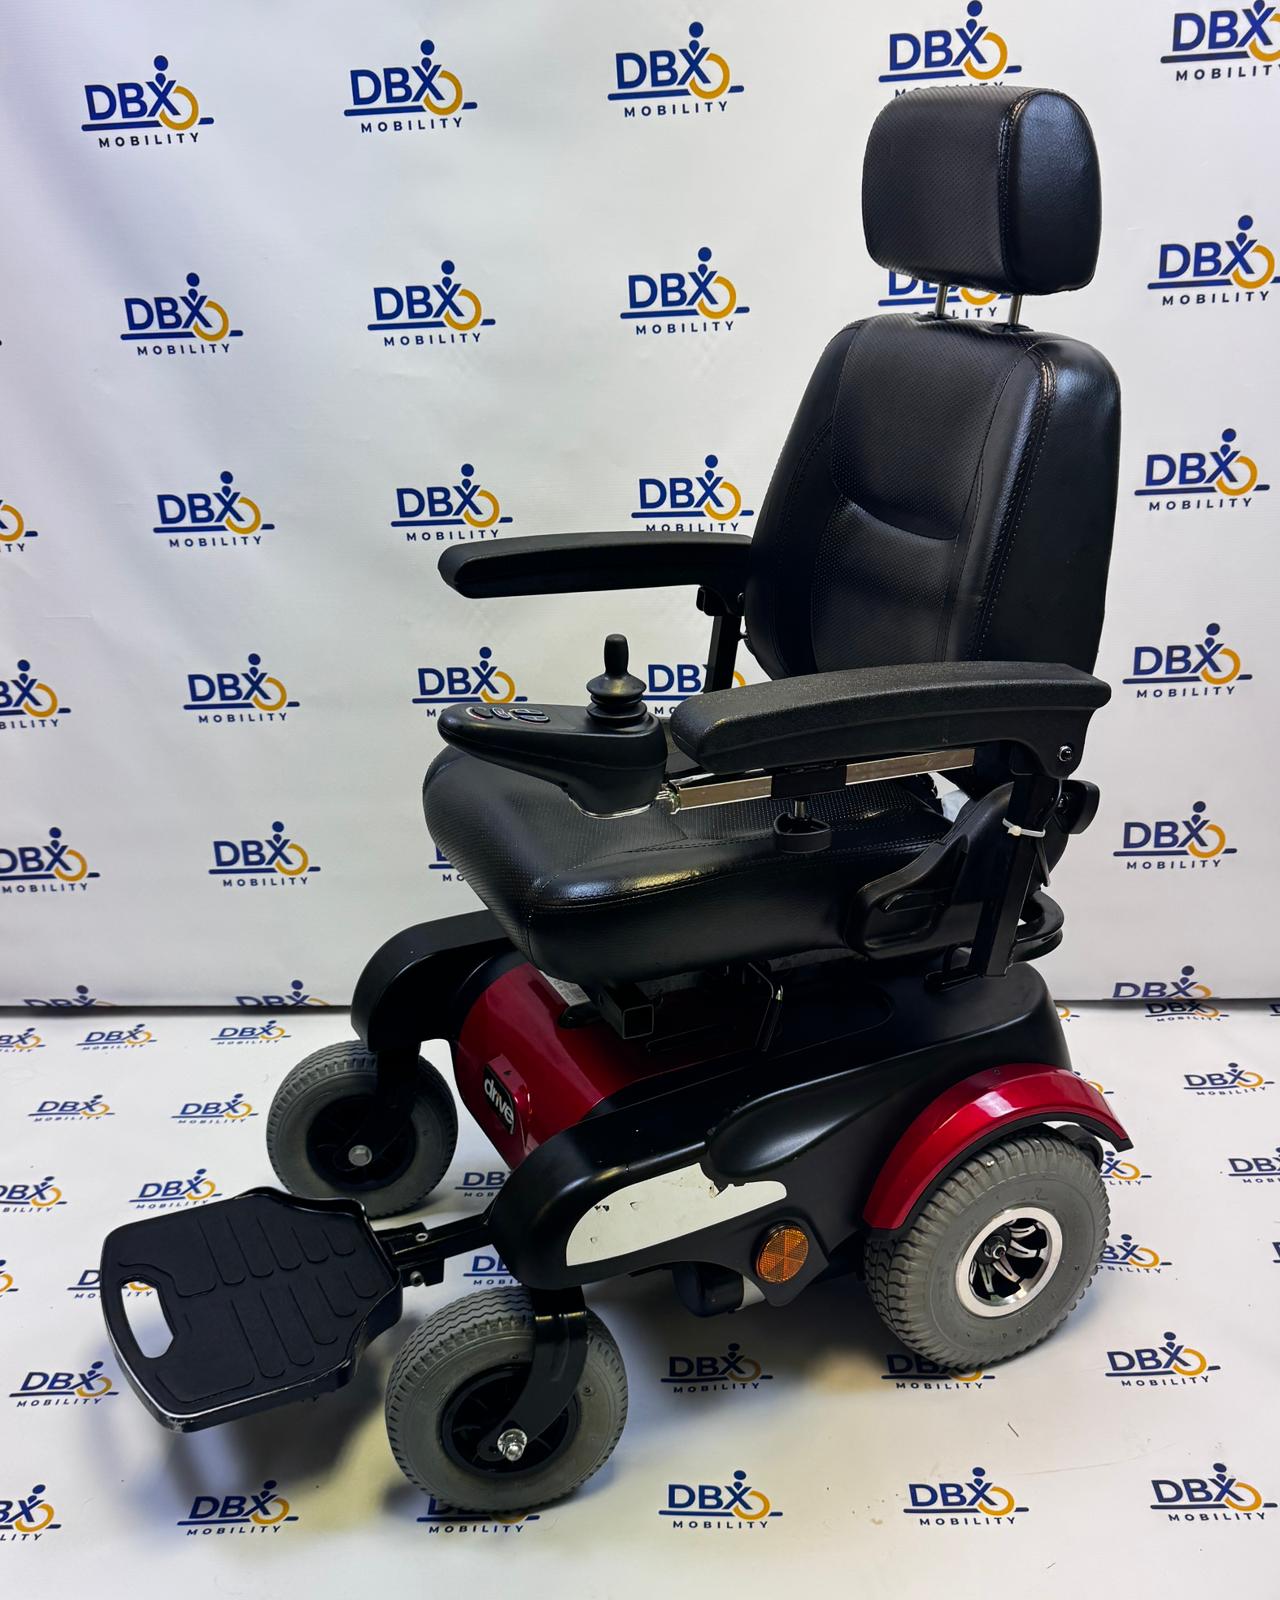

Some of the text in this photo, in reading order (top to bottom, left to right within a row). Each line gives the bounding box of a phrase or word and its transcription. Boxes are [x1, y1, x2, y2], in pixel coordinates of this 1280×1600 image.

[1174, 7, 1275, 52] DBX
[889, 27, 988, 70] DBX
[615, 48, 711, 89] DBX
[1175, 64, 1280, 81] MOBILIT
[351, 64, 448, 105] DBX
[85, 80, 181, 120] DBX
[624, 101, 729, 118] MOBILITY
[360, 116, 463, 133] MOBILITY
[98, 132, 200, 148] MOBILITY
[1159, 240, 1259, 280] DBX
[628, 272, 719, 309] DBX
[1162, 291, 1269, 306] MOBILITY
[373, 283, 464, 320] DBX
[125, 295, 212, 330] DBX
[636, 320, 735, 335] MOBILITY
[384, 332, 481, 347] MOBILITY
[137, 343, 231, 356] MOBILITY
[1146, 452, 1240, 486] DBX
[640, 477, 725, 509] DBX
[157, 491, 245, 524] DBX
[397, 485, 483, 518] DBX
[1148, 498, 1252, 511] MOBILITY
[169, 536, 262, 548] MOBILITY
[406, 529, 500, 541] MOBILITY
[1133, 644, 1223, 676] DBX
[418, 666, 500, 696] DBX
[648, 664, 702, 692] DB
[187, 672, 269, 702] DBX
[1137, 685, 1237, 699] MOBILITY
[198, 712, 287, 724] MOBILITY
[1123, 820, 1210, 849] DBX
[214, 838, 293, 866] DBX
[1126, 859, 1222, 871] MOBILITY
[2, 882, 88, 894] MOBILITY
[223, 876, 308, 887] MOBILITY
[1147, 1003, 1208, 1014] DBX
[85, 1031, 141, 1042] DBX
[218, 1026, 275, 1038] DBX
[1184, 1071, 1248, 1086] DBX
[1196, 1086, 1267, 1095] MOBILITY
[37, 1101, 100, 1113] DBX
[181, 1101, 242, 1115] DBX
[484, 1078, 515, 1133] drive
[463, 1172, 505, 1187] DB
[138, 1182, 202, 1199] DBX
[136, 1201, 209, 1209] MOBILITY
[669, 1353, 742, 1377] DBX
[1107, 1345, 1190, 1374] DBX
[20, 1371, 103, 1391] DBX
[673, 1383, 759, 1393] MOBILITY
[895, 1381, 984, 1390] MOBILITY
[1121, 1375, 1209, 1387] MOBILITY
[17, 1397, 102, 1408] MOBILITY
[669, 1483, 751, 1510] DBX
[910, 1482, 998, 1507] DBX
[1152, 1478, 1246, 1504] DBX
[189, 1496, 276, 1520] DBX
[673, 1520, 768, 1529] MOBILITY
[920, 1516, 1016, 1525] MOBILITY
[1168, 1512, 1266, 1522] MOBILITY
[186, 1526, 282, 1536] MOBILITY
[429, 1525, 524, 1533] MOBILITY
